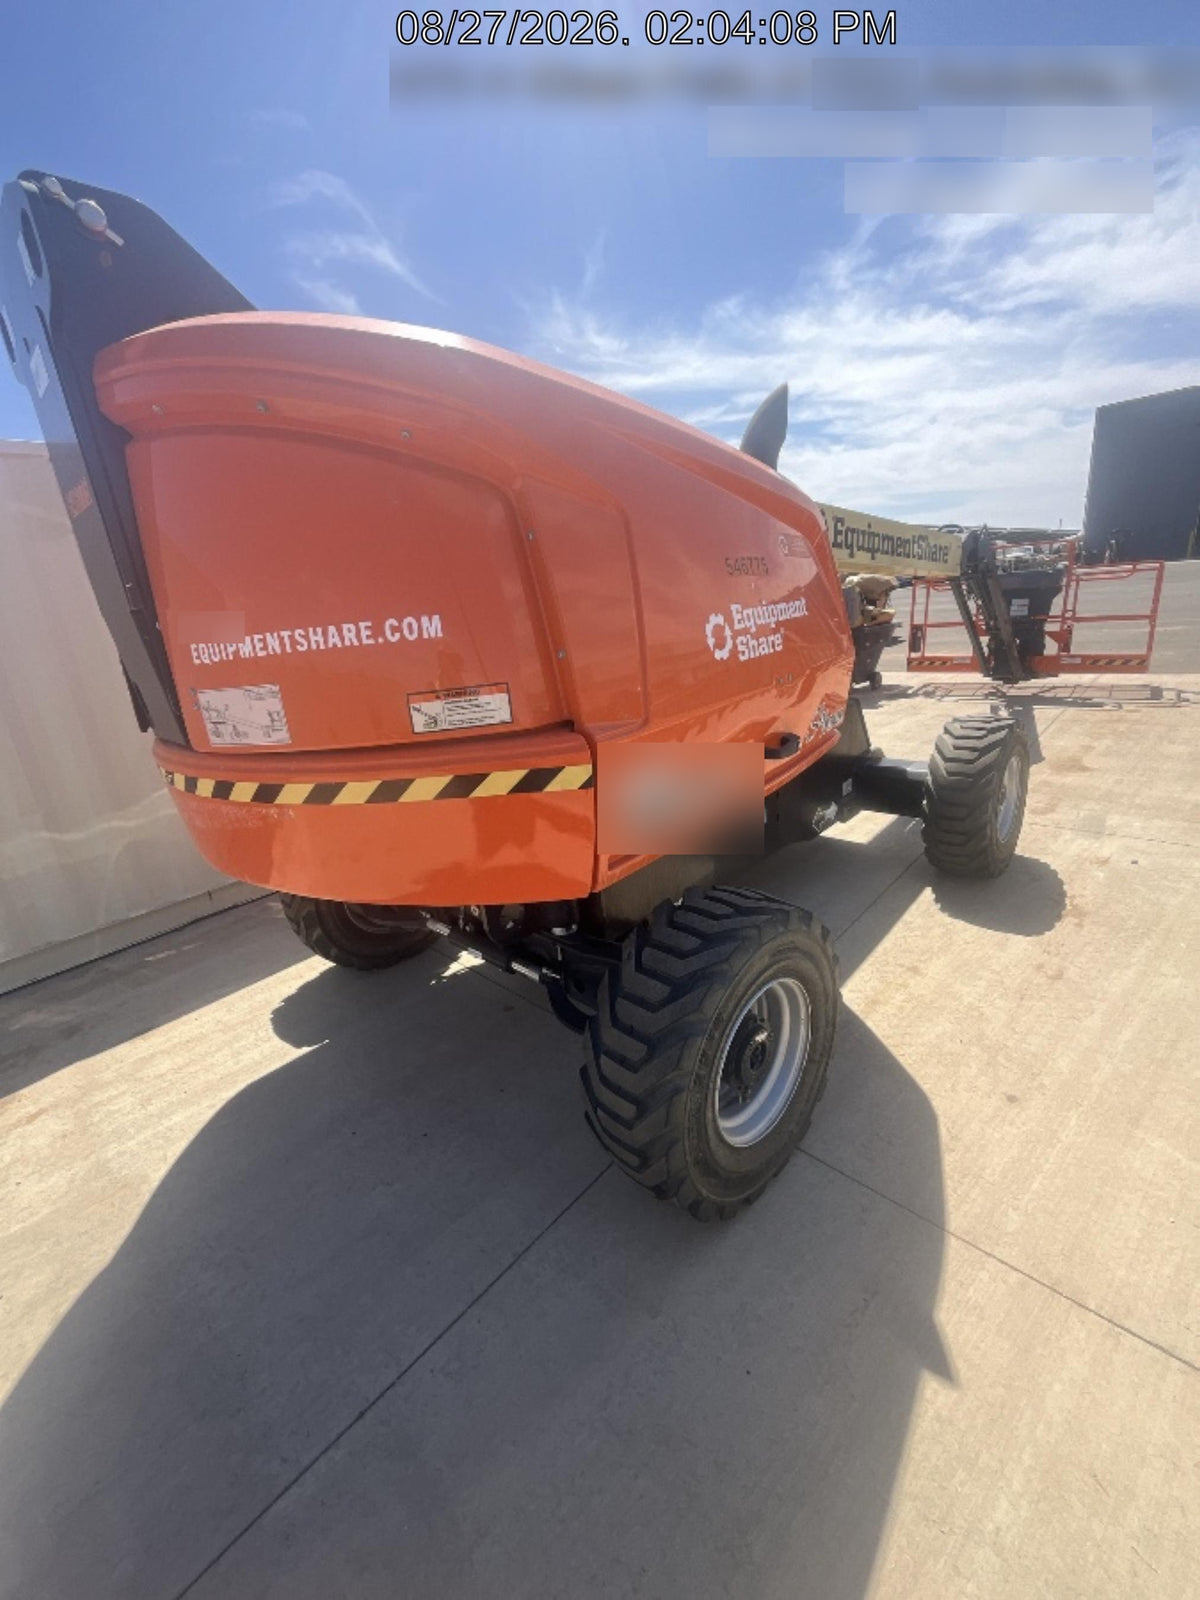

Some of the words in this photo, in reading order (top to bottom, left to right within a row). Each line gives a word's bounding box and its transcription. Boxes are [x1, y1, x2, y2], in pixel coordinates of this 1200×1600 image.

[832, 516, 949, 563] EquipmentShare
[730, 600, 808, 632] Equipment
[190, 614, 443, 665] EQUIPMENTSHARE.COM
[736, 632, 784, 662] Share
